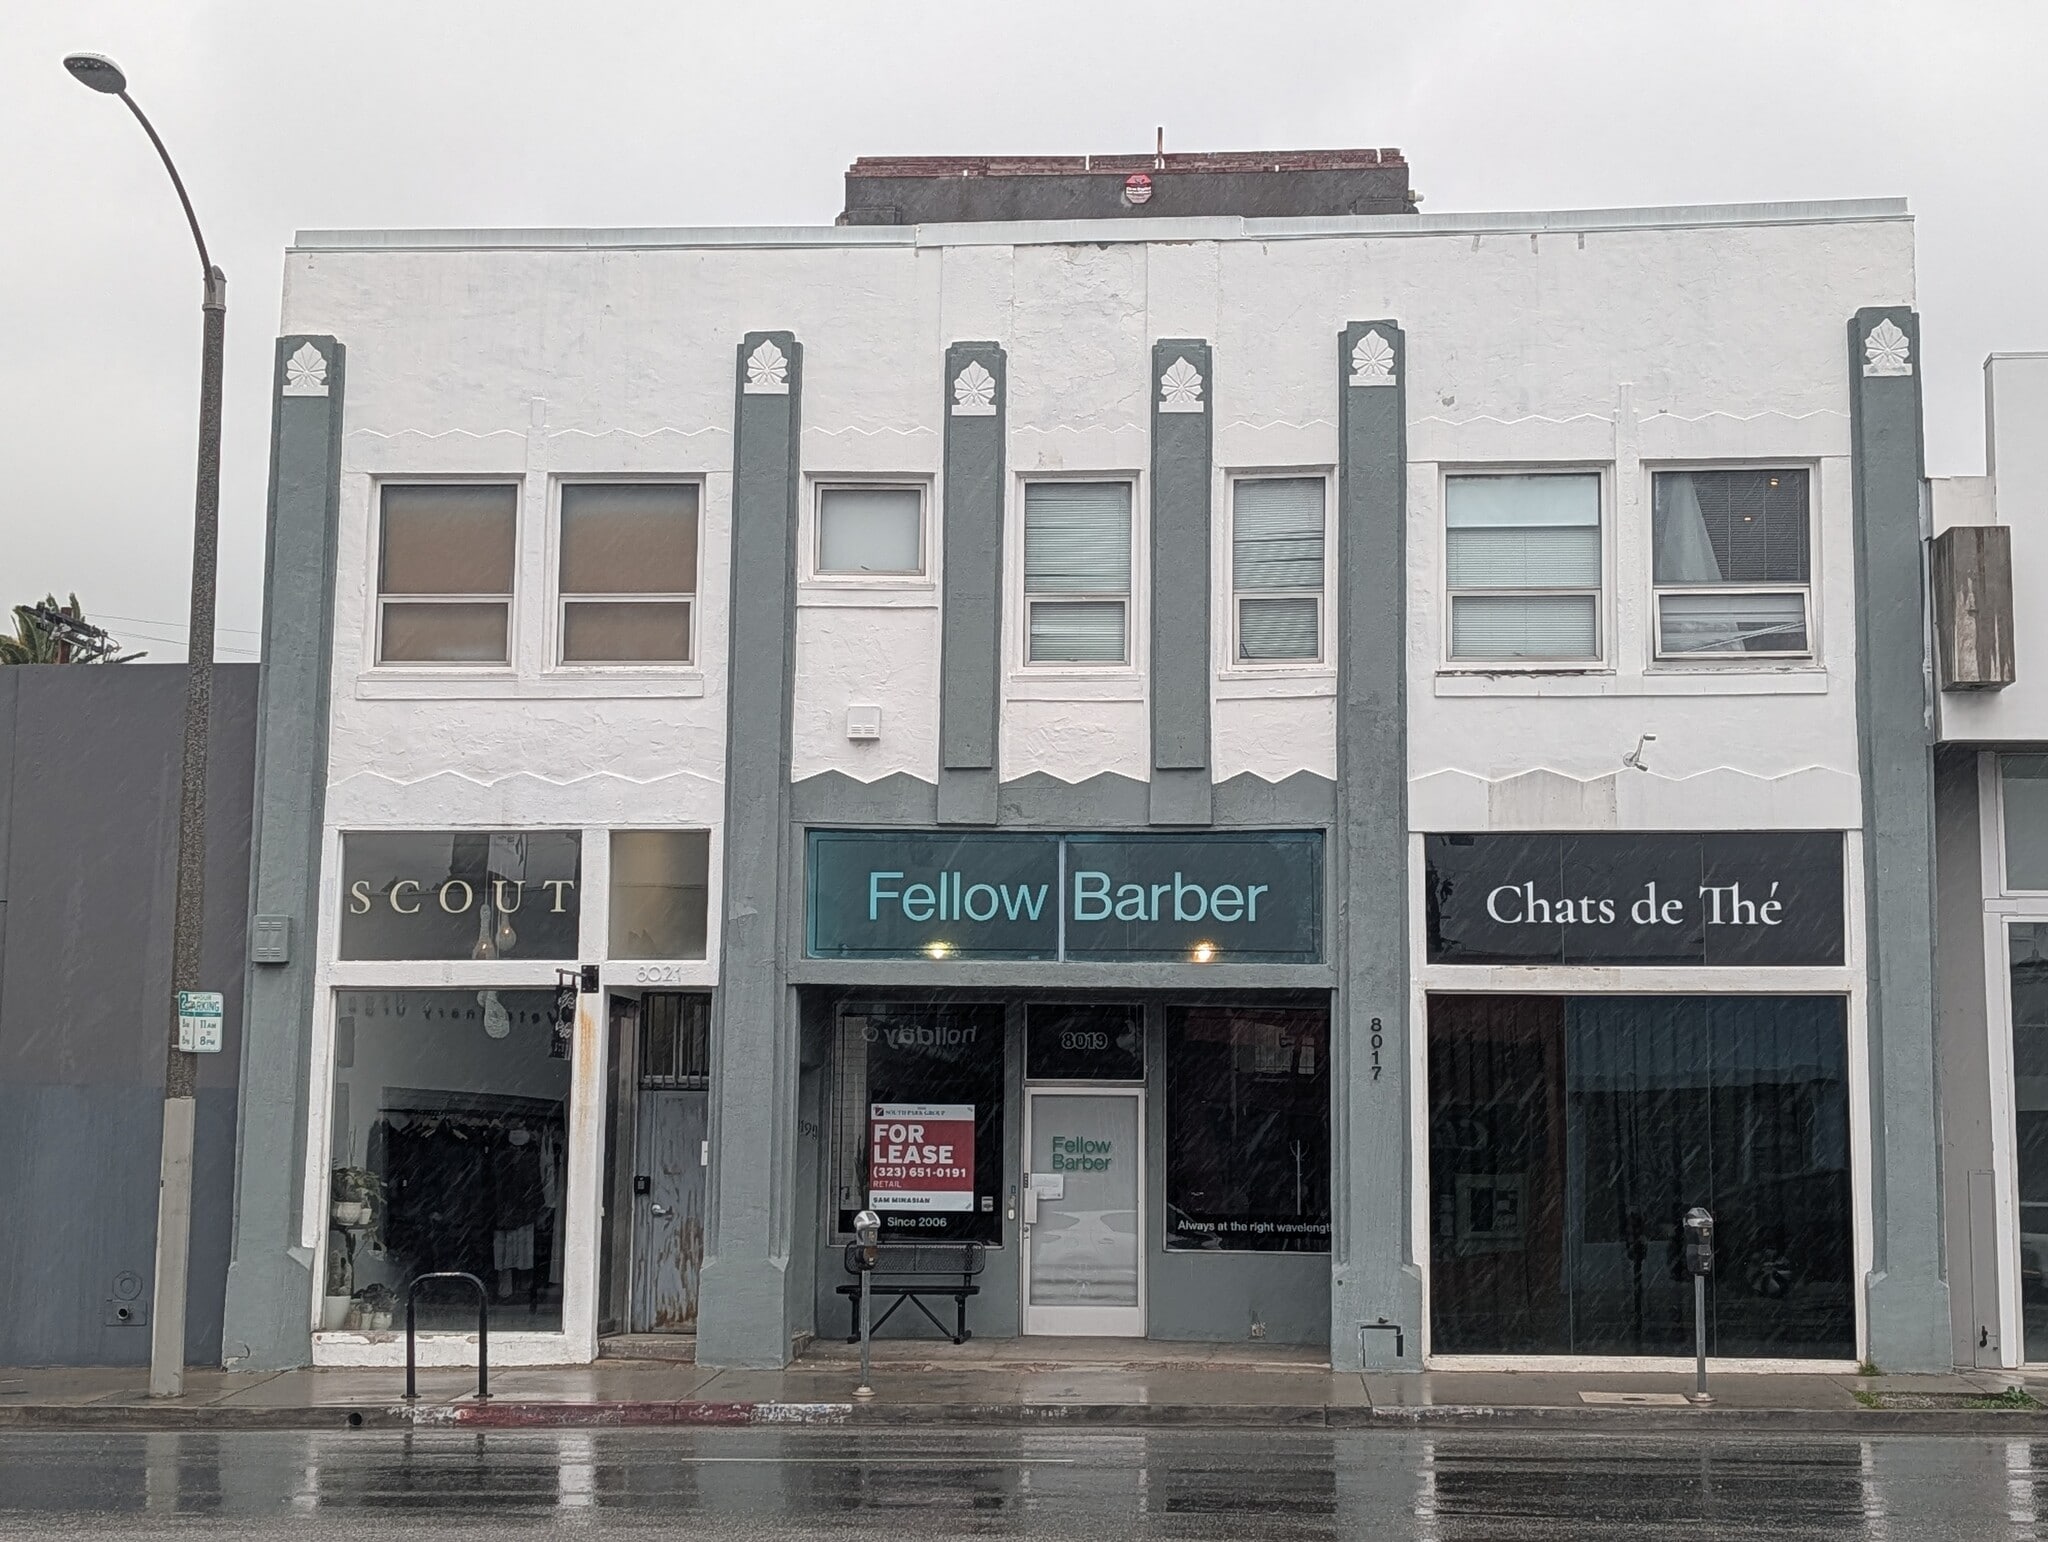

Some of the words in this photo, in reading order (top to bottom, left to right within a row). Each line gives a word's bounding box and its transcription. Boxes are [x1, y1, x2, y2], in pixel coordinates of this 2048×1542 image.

[350, 880, 574, 914] SCOUT
[869, 872, 1048, 921] Fellow
[1074, 872, 1268, 922] Barber
[1487, 881, 1615, 924] Chats
[1631, 881, 1684, 924] de
[1699, 881, 1782, 925] Thé
[636, 965, 682, 983] 8021
[190, 1001, 220, 1012] RKING
[1061, 1031, 1108, 1050] 8019
[1370, 1017, 1383, 1080] 8017
[874, 1124, 924, 1143] FOR
[1052, 1136, 1111, 1154] Fellow
[874, 1145, 954, 1164] LEASE
[1052, 1153, 1111, 1171] Barber
[873, 1166, 906, 1179] (323)
[909, 1167, 966, 1178] 651-0191
[887, 1216, 916, 1227] Since
[918, 1217, 948, 1227] 2006
[1177, 1220, 1215, 1232] Always
[1217, 1221, 1227, 1231] at
[1230, 1221, 1247, 1231] the
[1250, 1222, 1275, 1234] right
[1276, 1223, 1332, 1234] wavelengt
